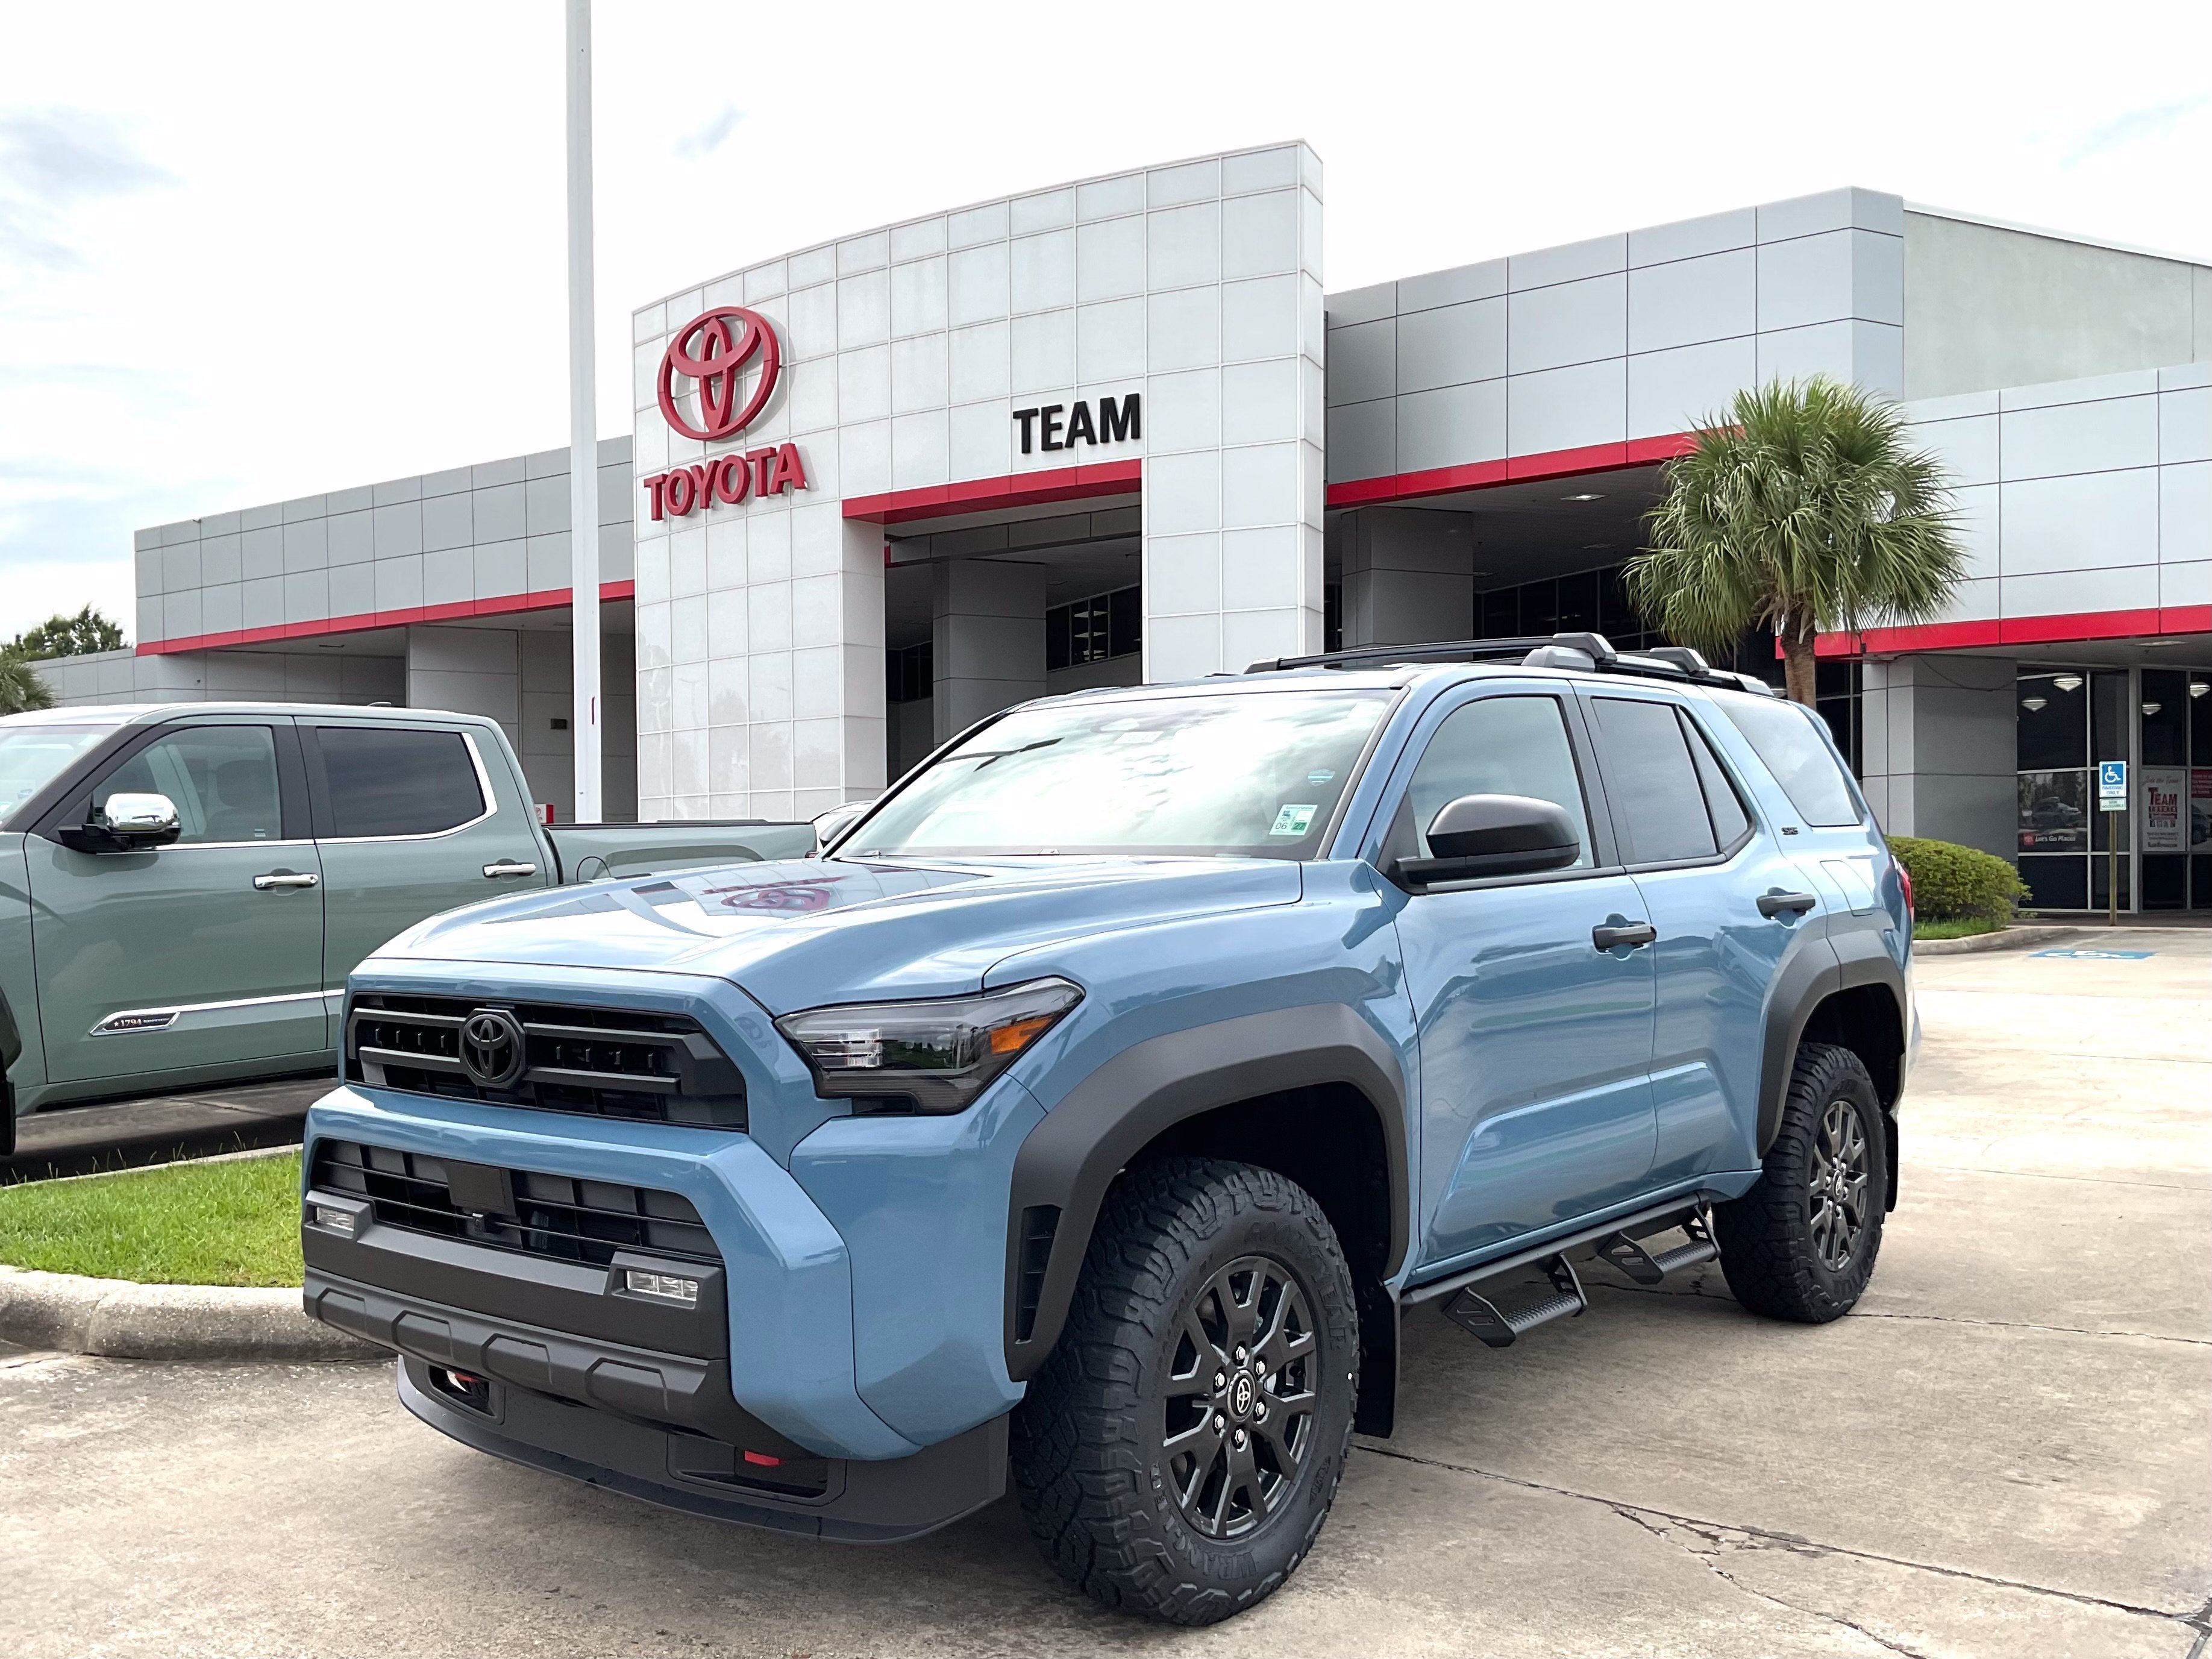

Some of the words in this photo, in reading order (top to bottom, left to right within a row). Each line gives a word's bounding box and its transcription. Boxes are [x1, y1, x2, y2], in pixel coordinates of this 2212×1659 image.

[1013, 393, 1140, 454] TEAM
[644, 442, 806, 521] TOYOTA
[2148, 787, 2178, 806] TEAM
